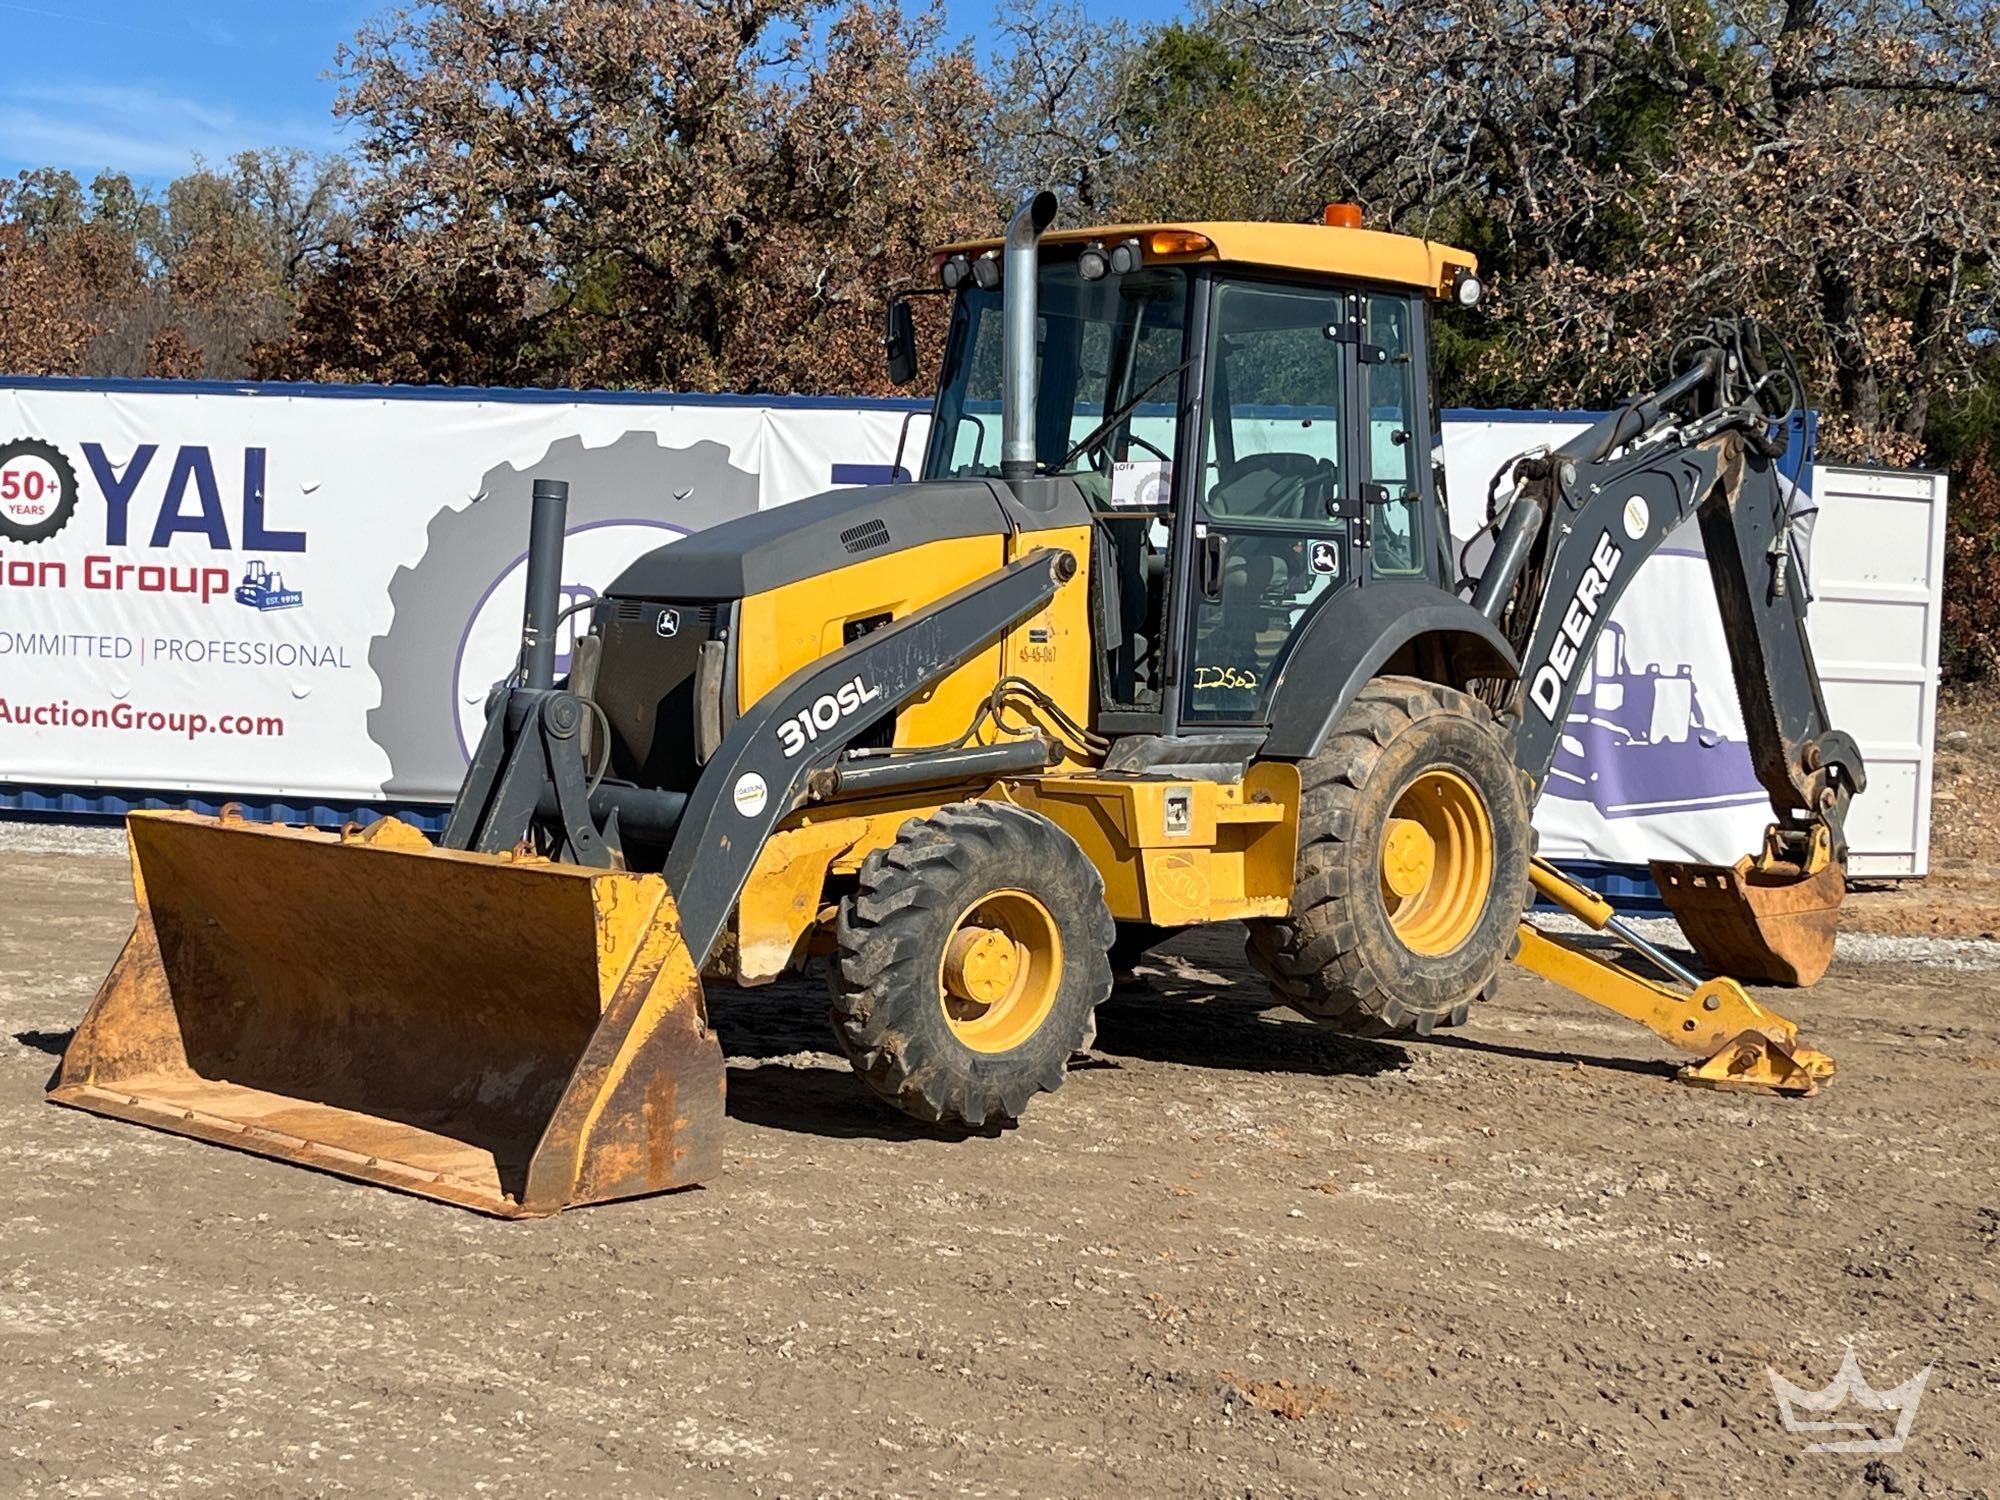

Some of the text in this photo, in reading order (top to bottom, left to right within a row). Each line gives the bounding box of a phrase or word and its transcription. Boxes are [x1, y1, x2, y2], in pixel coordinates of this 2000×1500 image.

[1, 470, 58, 500] 50+
[9, 504, 45, 515] YEARS
[84, 555, 230, 604] Group
[1529, 531, 1622, 721] DEERE
[153, 637, 352, 669] PROFESSIONAL
[776, 675, 883, 758] 310SL
